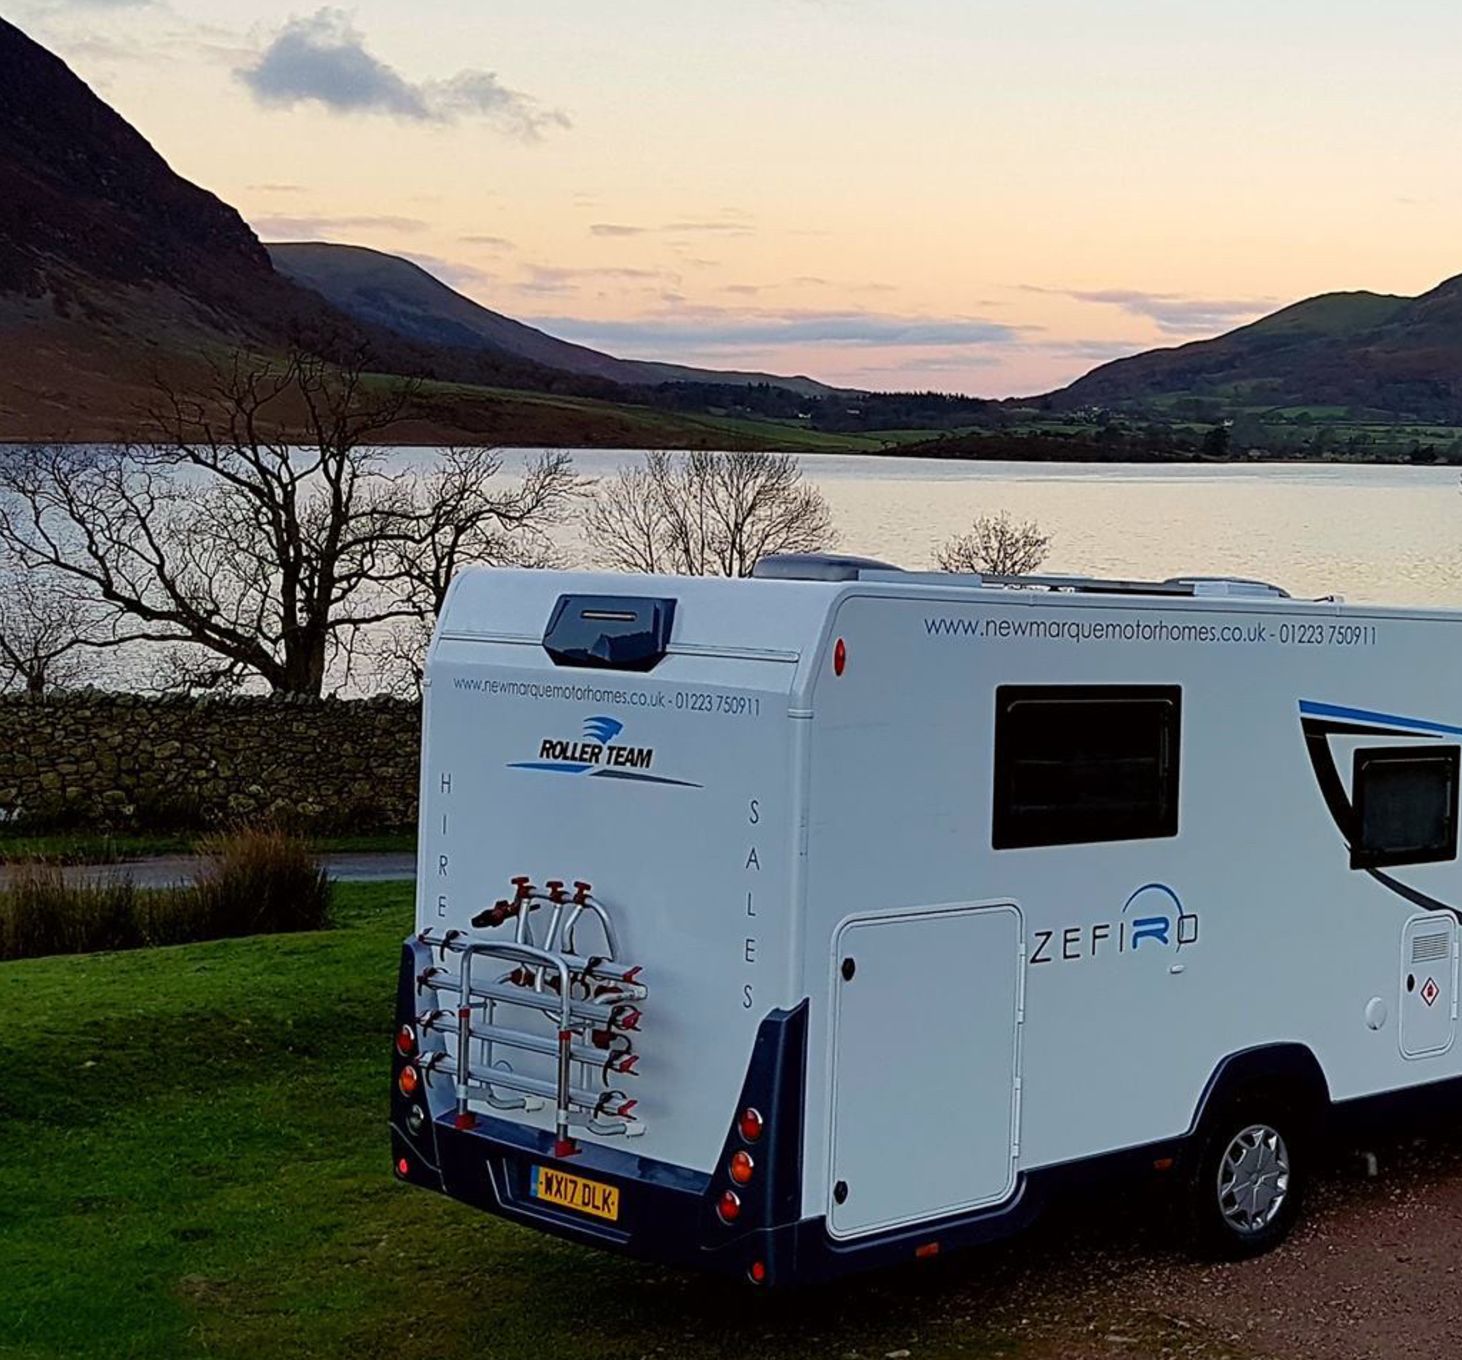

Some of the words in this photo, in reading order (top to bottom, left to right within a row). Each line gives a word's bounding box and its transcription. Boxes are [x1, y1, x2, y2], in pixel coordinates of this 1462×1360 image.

[925, 618, 1266, 642] www.newmarquemotorhomes.co.uk
[1279, 623, 1324, 644] 01223
[1329, 624, 1376, 645] 750911
[453, 677, 666, 708] www.newmarquemotorhomes.co.uk
[675, 691, 713, 712] 01223
[716, 694, 760, 717] 750911
[539, 739, 603, 764] ROLLER
[606, 745, 653, 768] TEAM
[438, 773, 451, 918] HIRE
[742, 799, 761, 1009] SALES
[1029, 913, 1198, 965] ZEFIRO
[544, 1172, 577, 1203] WX17
[582, 1183, 612, 1213] DLK
